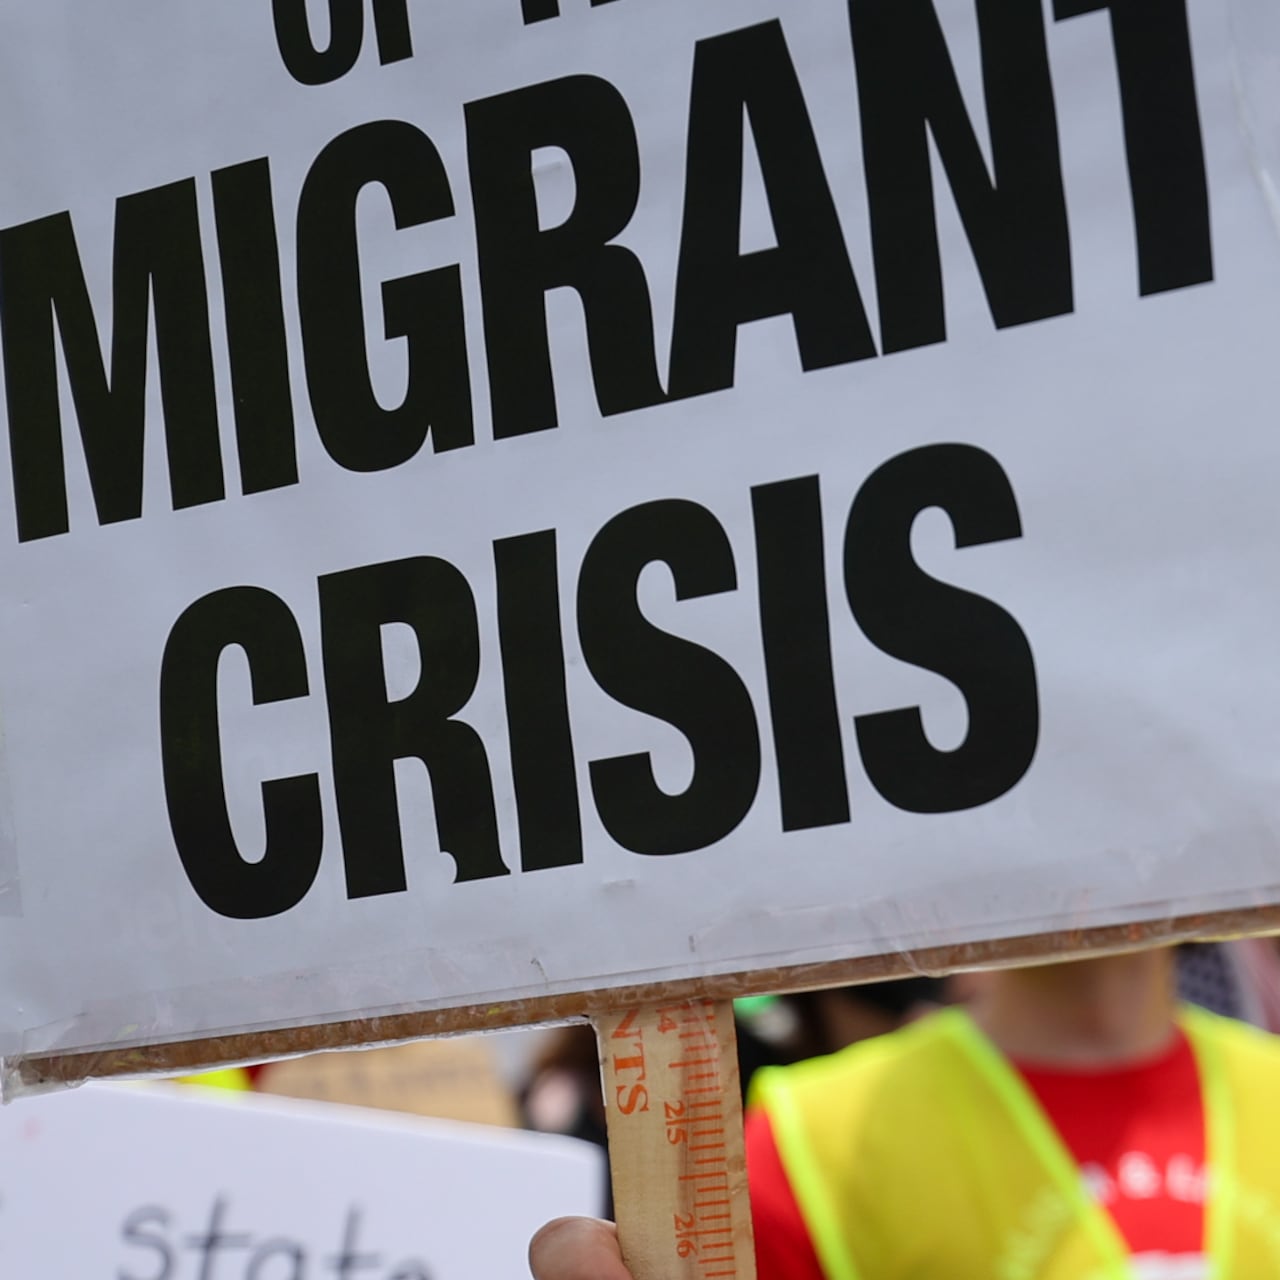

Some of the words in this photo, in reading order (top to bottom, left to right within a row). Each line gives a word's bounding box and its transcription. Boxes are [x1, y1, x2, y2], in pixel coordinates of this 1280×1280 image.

[0, 0, 1214, 543] MIGRANT
[159, 442, 1040, 919] CRISIS
[663, 1100, 689, 1146] 25
[672, 1213, 697, 1259] 26
